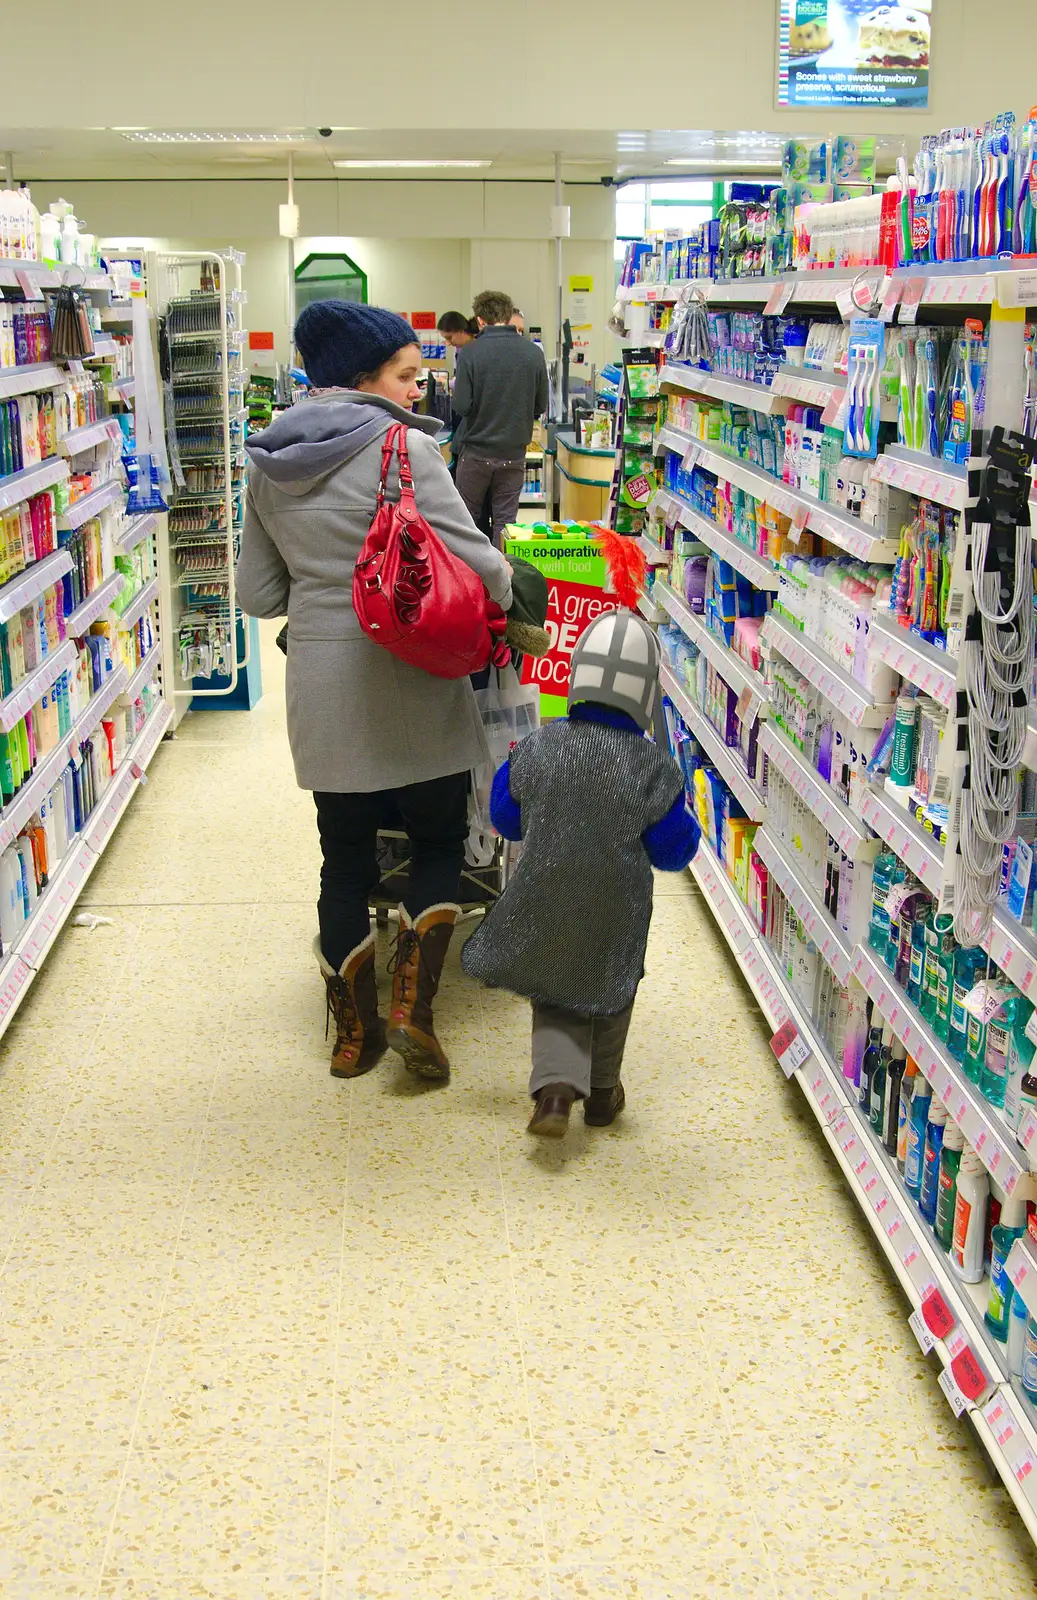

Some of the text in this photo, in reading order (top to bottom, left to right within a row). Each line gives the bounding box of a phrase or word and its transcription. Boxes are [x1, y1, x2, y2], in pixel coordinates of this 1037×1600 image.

[795, 71, 917, 85] Scones with sweet strawberry
[795, 83, 886, 94] preserve, scrumptious
[630, 480, 648, 493] DEAL
[512, 545, 530, 558] The
[542, 560, 565, 573] with
[568, 560, 592, 573] food
[547, 586, 560, 615] A
[543, 620, 579, 653] DE
[898, 731, 909, 770] freshmint
[988, 996, 1000, 1009] TRY
